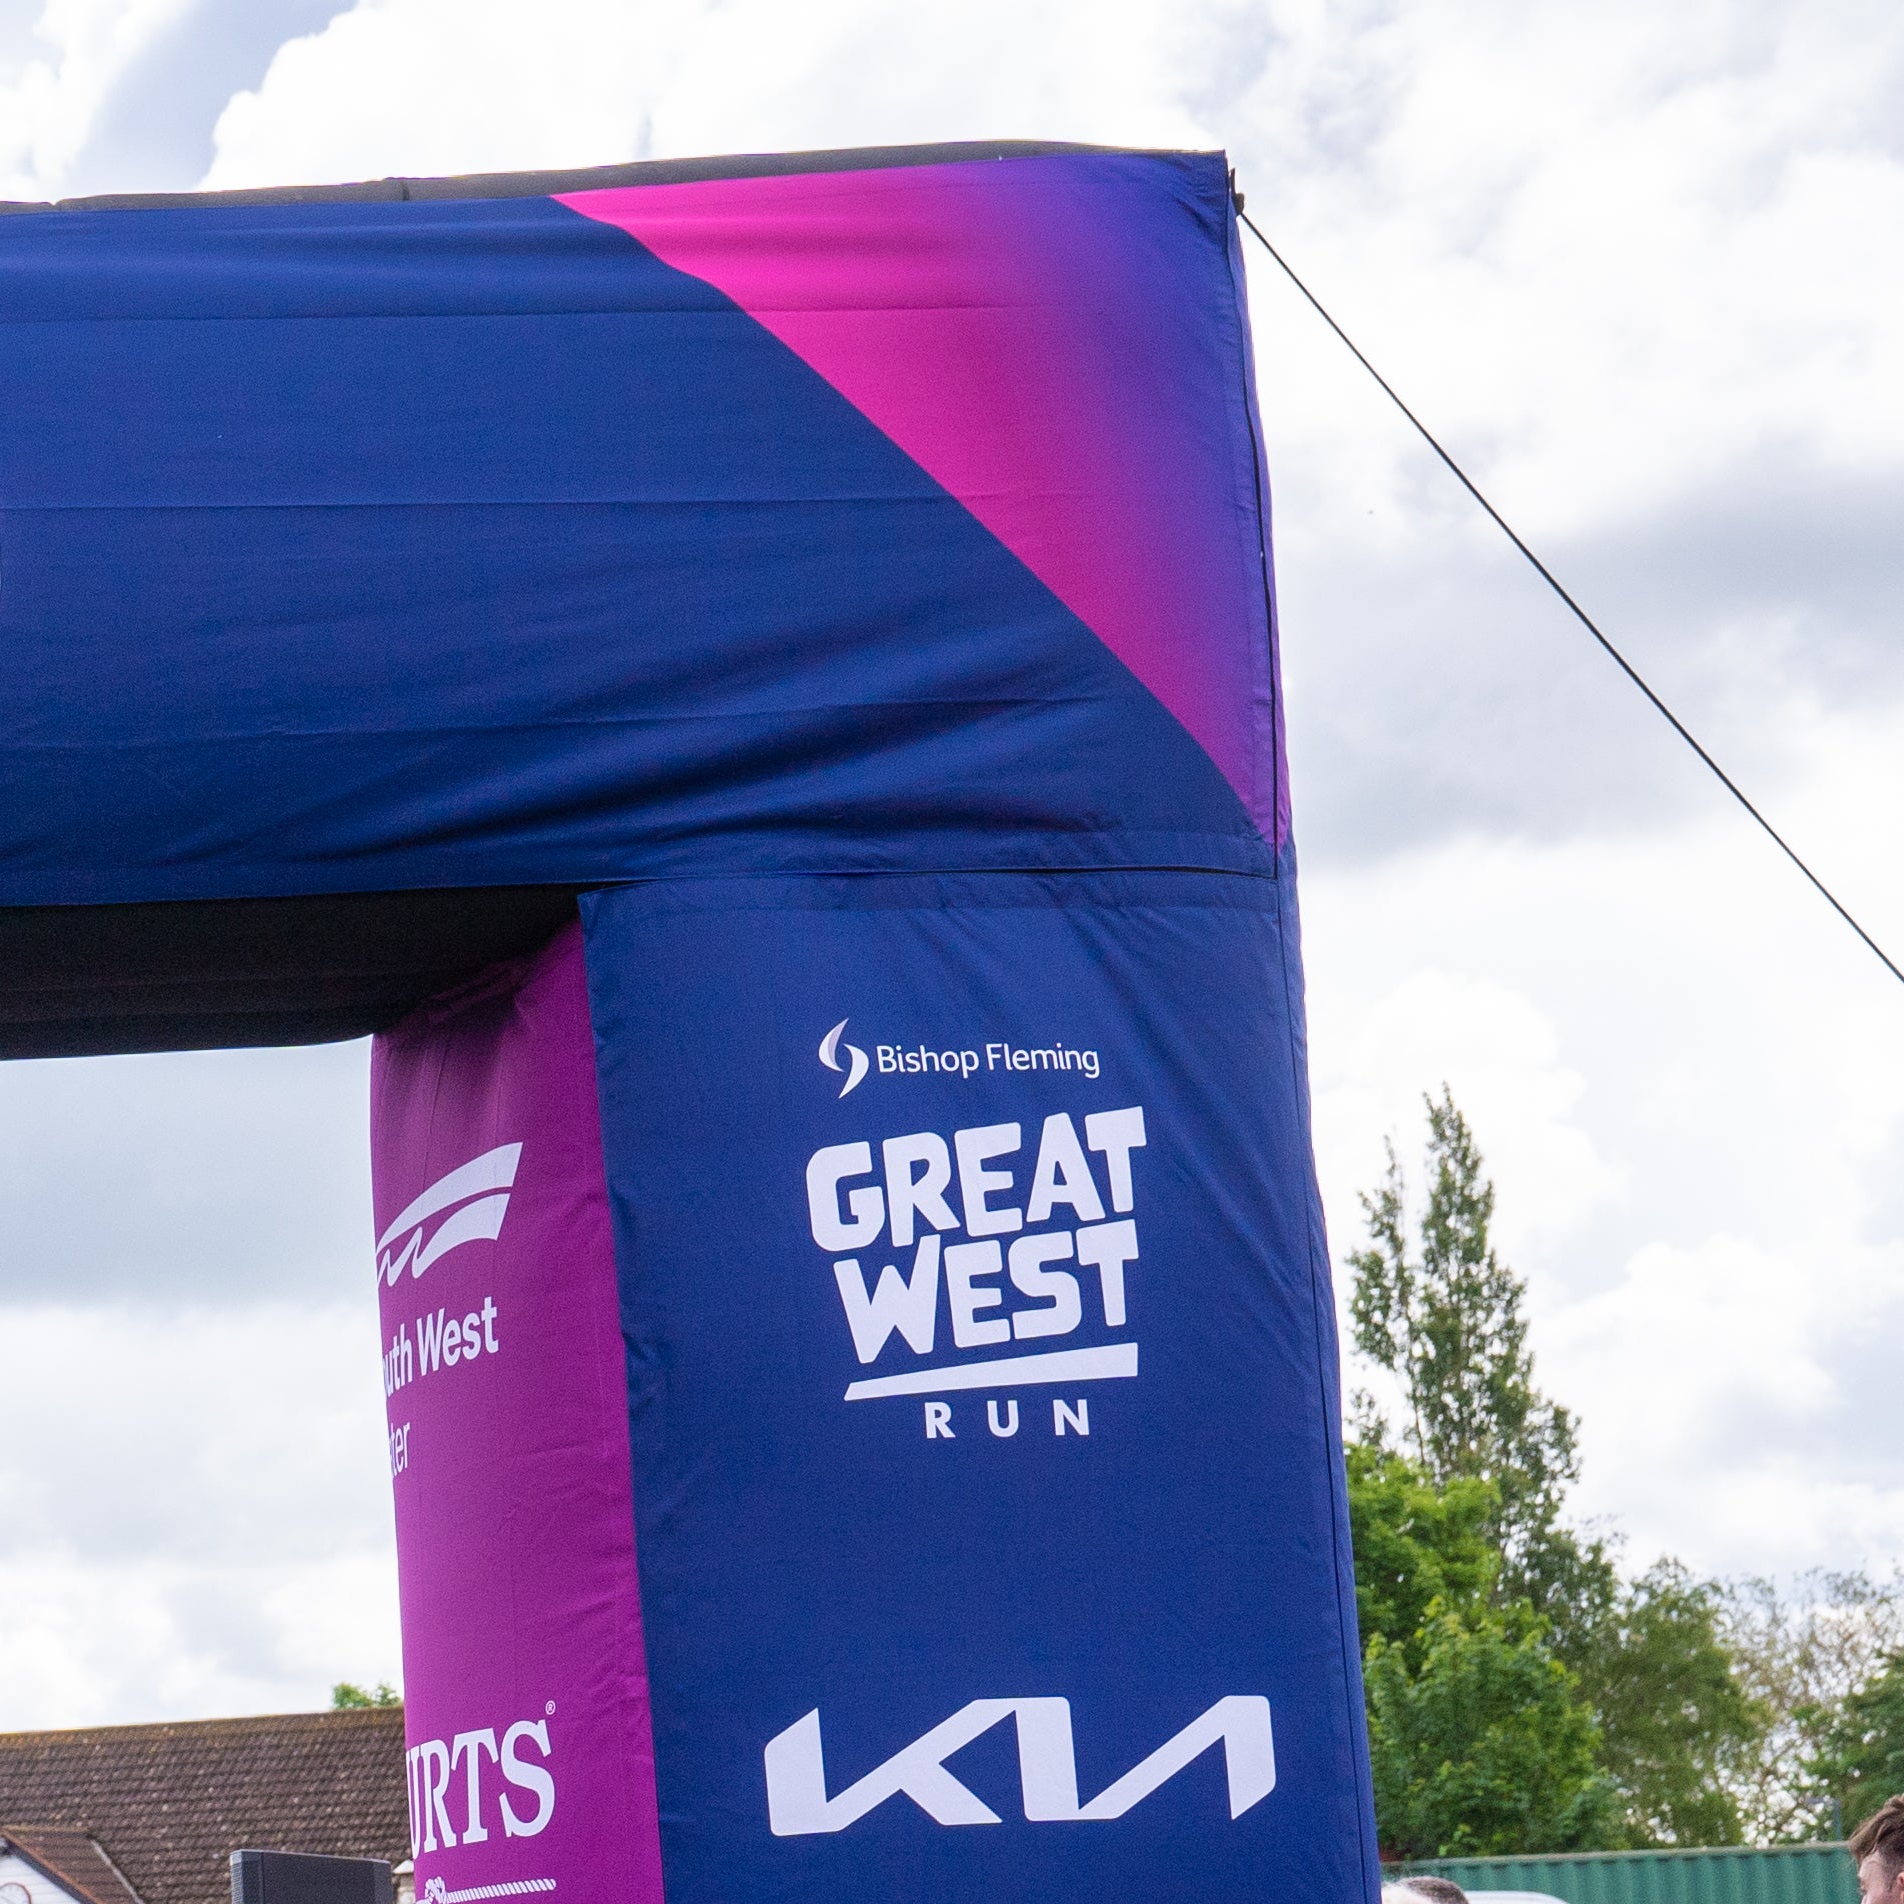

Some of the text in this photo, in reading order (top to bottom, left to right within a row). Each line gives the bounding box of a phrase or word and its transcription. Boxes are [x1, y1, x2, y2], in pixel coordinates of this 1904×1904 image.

[877, 1043, 1099, 1078] Bishop Fleming
[806, 1106, 1146, 1259] GREAT
[417, 1295, 500, 1373] West
[833, 1219, 1140, 1364] WEST
[925, 1399, 1089, 1438] RUN
[764, 1696, 1276, 1836] KIA
